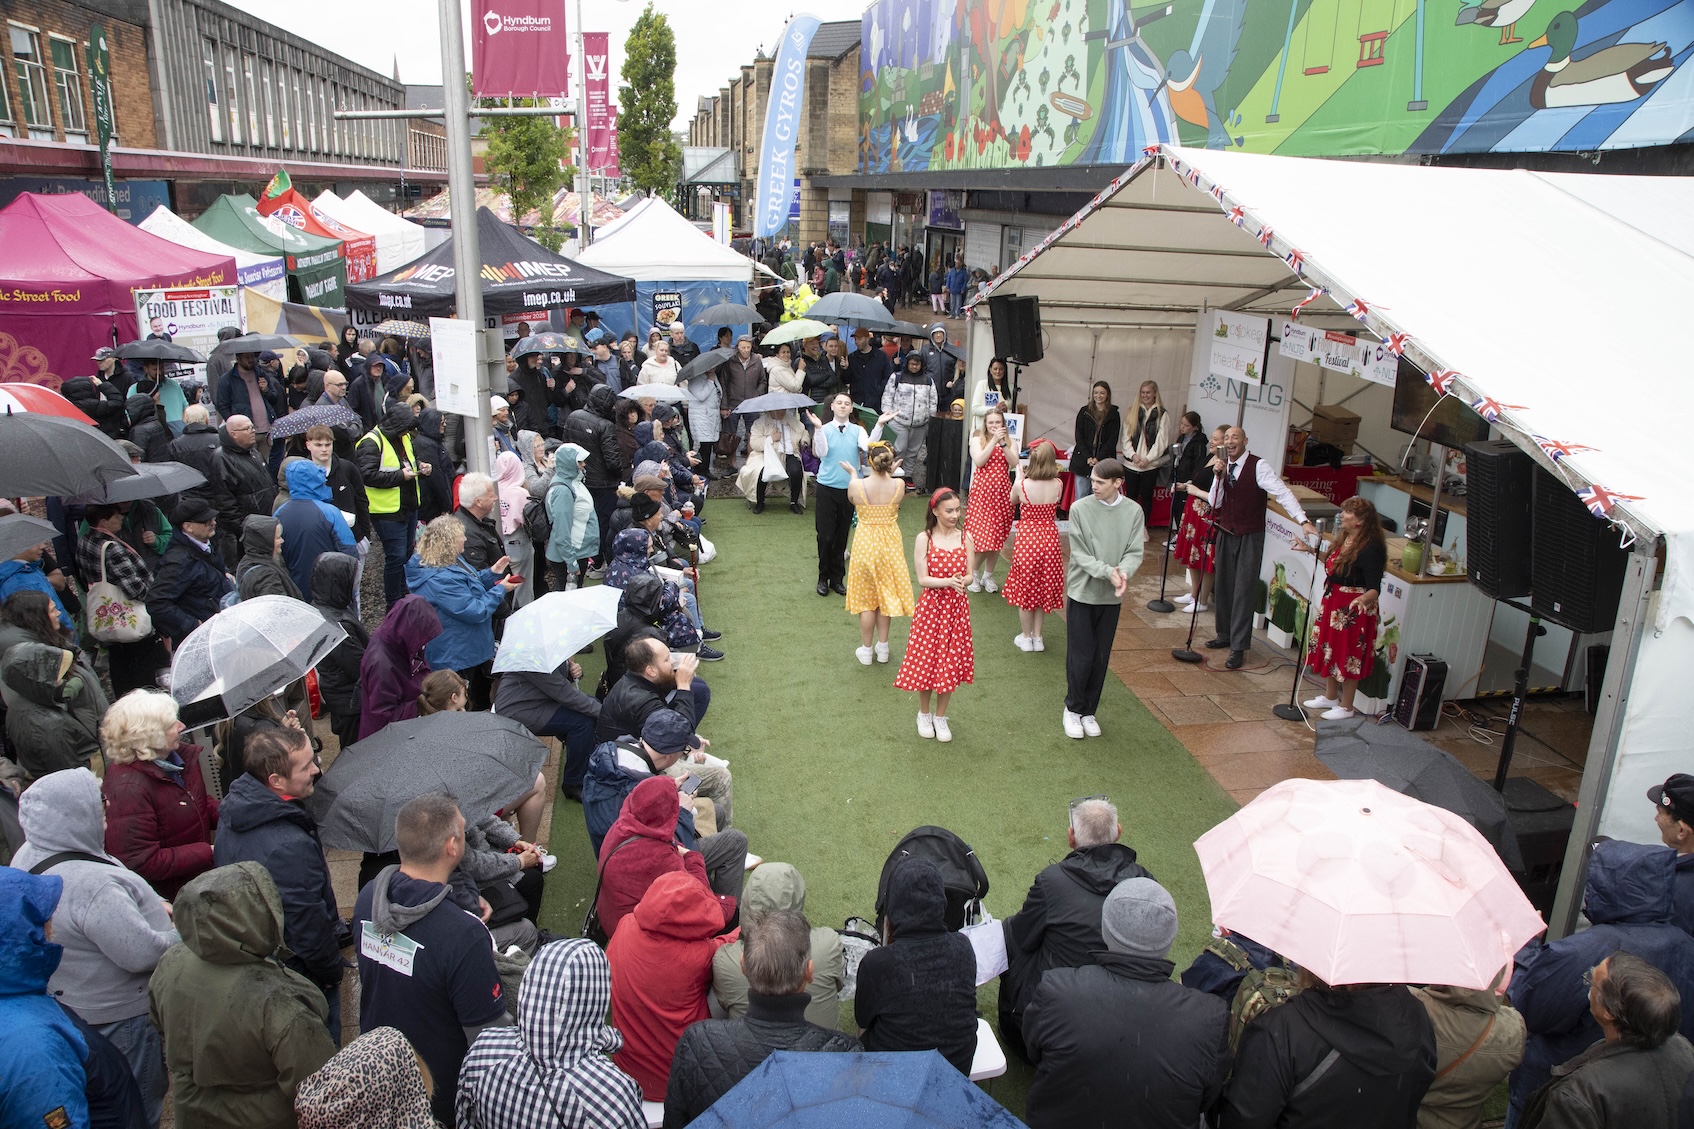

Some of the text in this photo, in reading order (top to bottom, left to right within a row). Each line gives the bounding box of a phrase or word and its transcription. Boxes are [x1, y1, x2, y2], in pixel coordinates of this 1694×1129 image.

[503, 15, 551, 27] Hyndburn
[503, 25, 529, 33] Borough
[766, 57, 802, 230] GREEK GYROS
[211, 269, 224, 285] Food
[514, 261, 572, 279] IMEP
[13, 288, 50, 302] Street
[51, 289, 81, 303] Food
[379, 292, 412, 310] imep.co.uk
[523, 288, 576, 308] imep.co.uk
[654, 294, 680, 302] GREEK
[147, 298, 236, 318] FOOD FESTIVAL
[654, 300, 681, 310] SOUVLAKI
[503, 314, 533, 324] September
[532, 312, 547, 320] 2025
[178, 322, 206, 332] Hyndburn
[1288, 342, 1305, 355] NLTG
[1325, 352, 1350, 369] Festival
[1266, 517, 1293, 539] Hyndburn
[1508, 697, 1521, 726] PULSE
[362, 938, 410, 968] HANGAR 42
